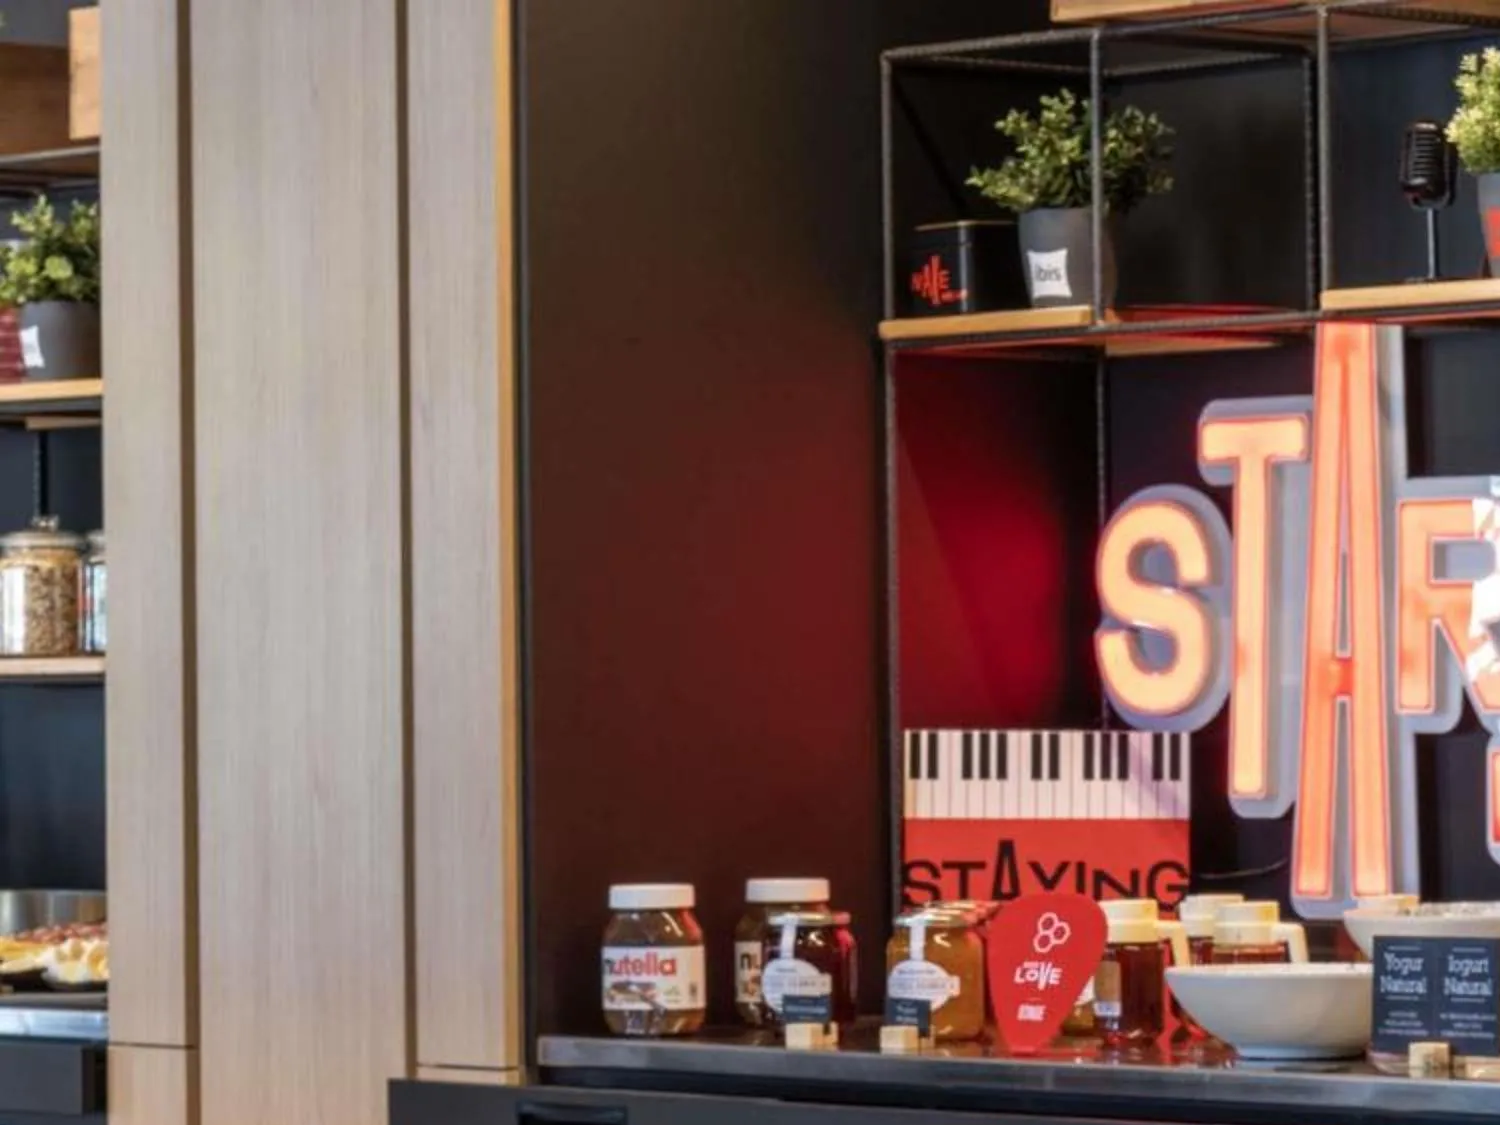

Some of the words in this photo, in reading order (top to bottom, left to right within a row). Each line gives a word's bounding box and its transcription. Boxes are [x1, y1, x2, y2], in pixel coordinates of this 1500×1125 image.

[902, 839, 1190, 911] STAYING
[604, 950, 677, 977] nutella
[1379, 976, 1427, 994] Natural
[1443, 976, 1493, 996] Natural
